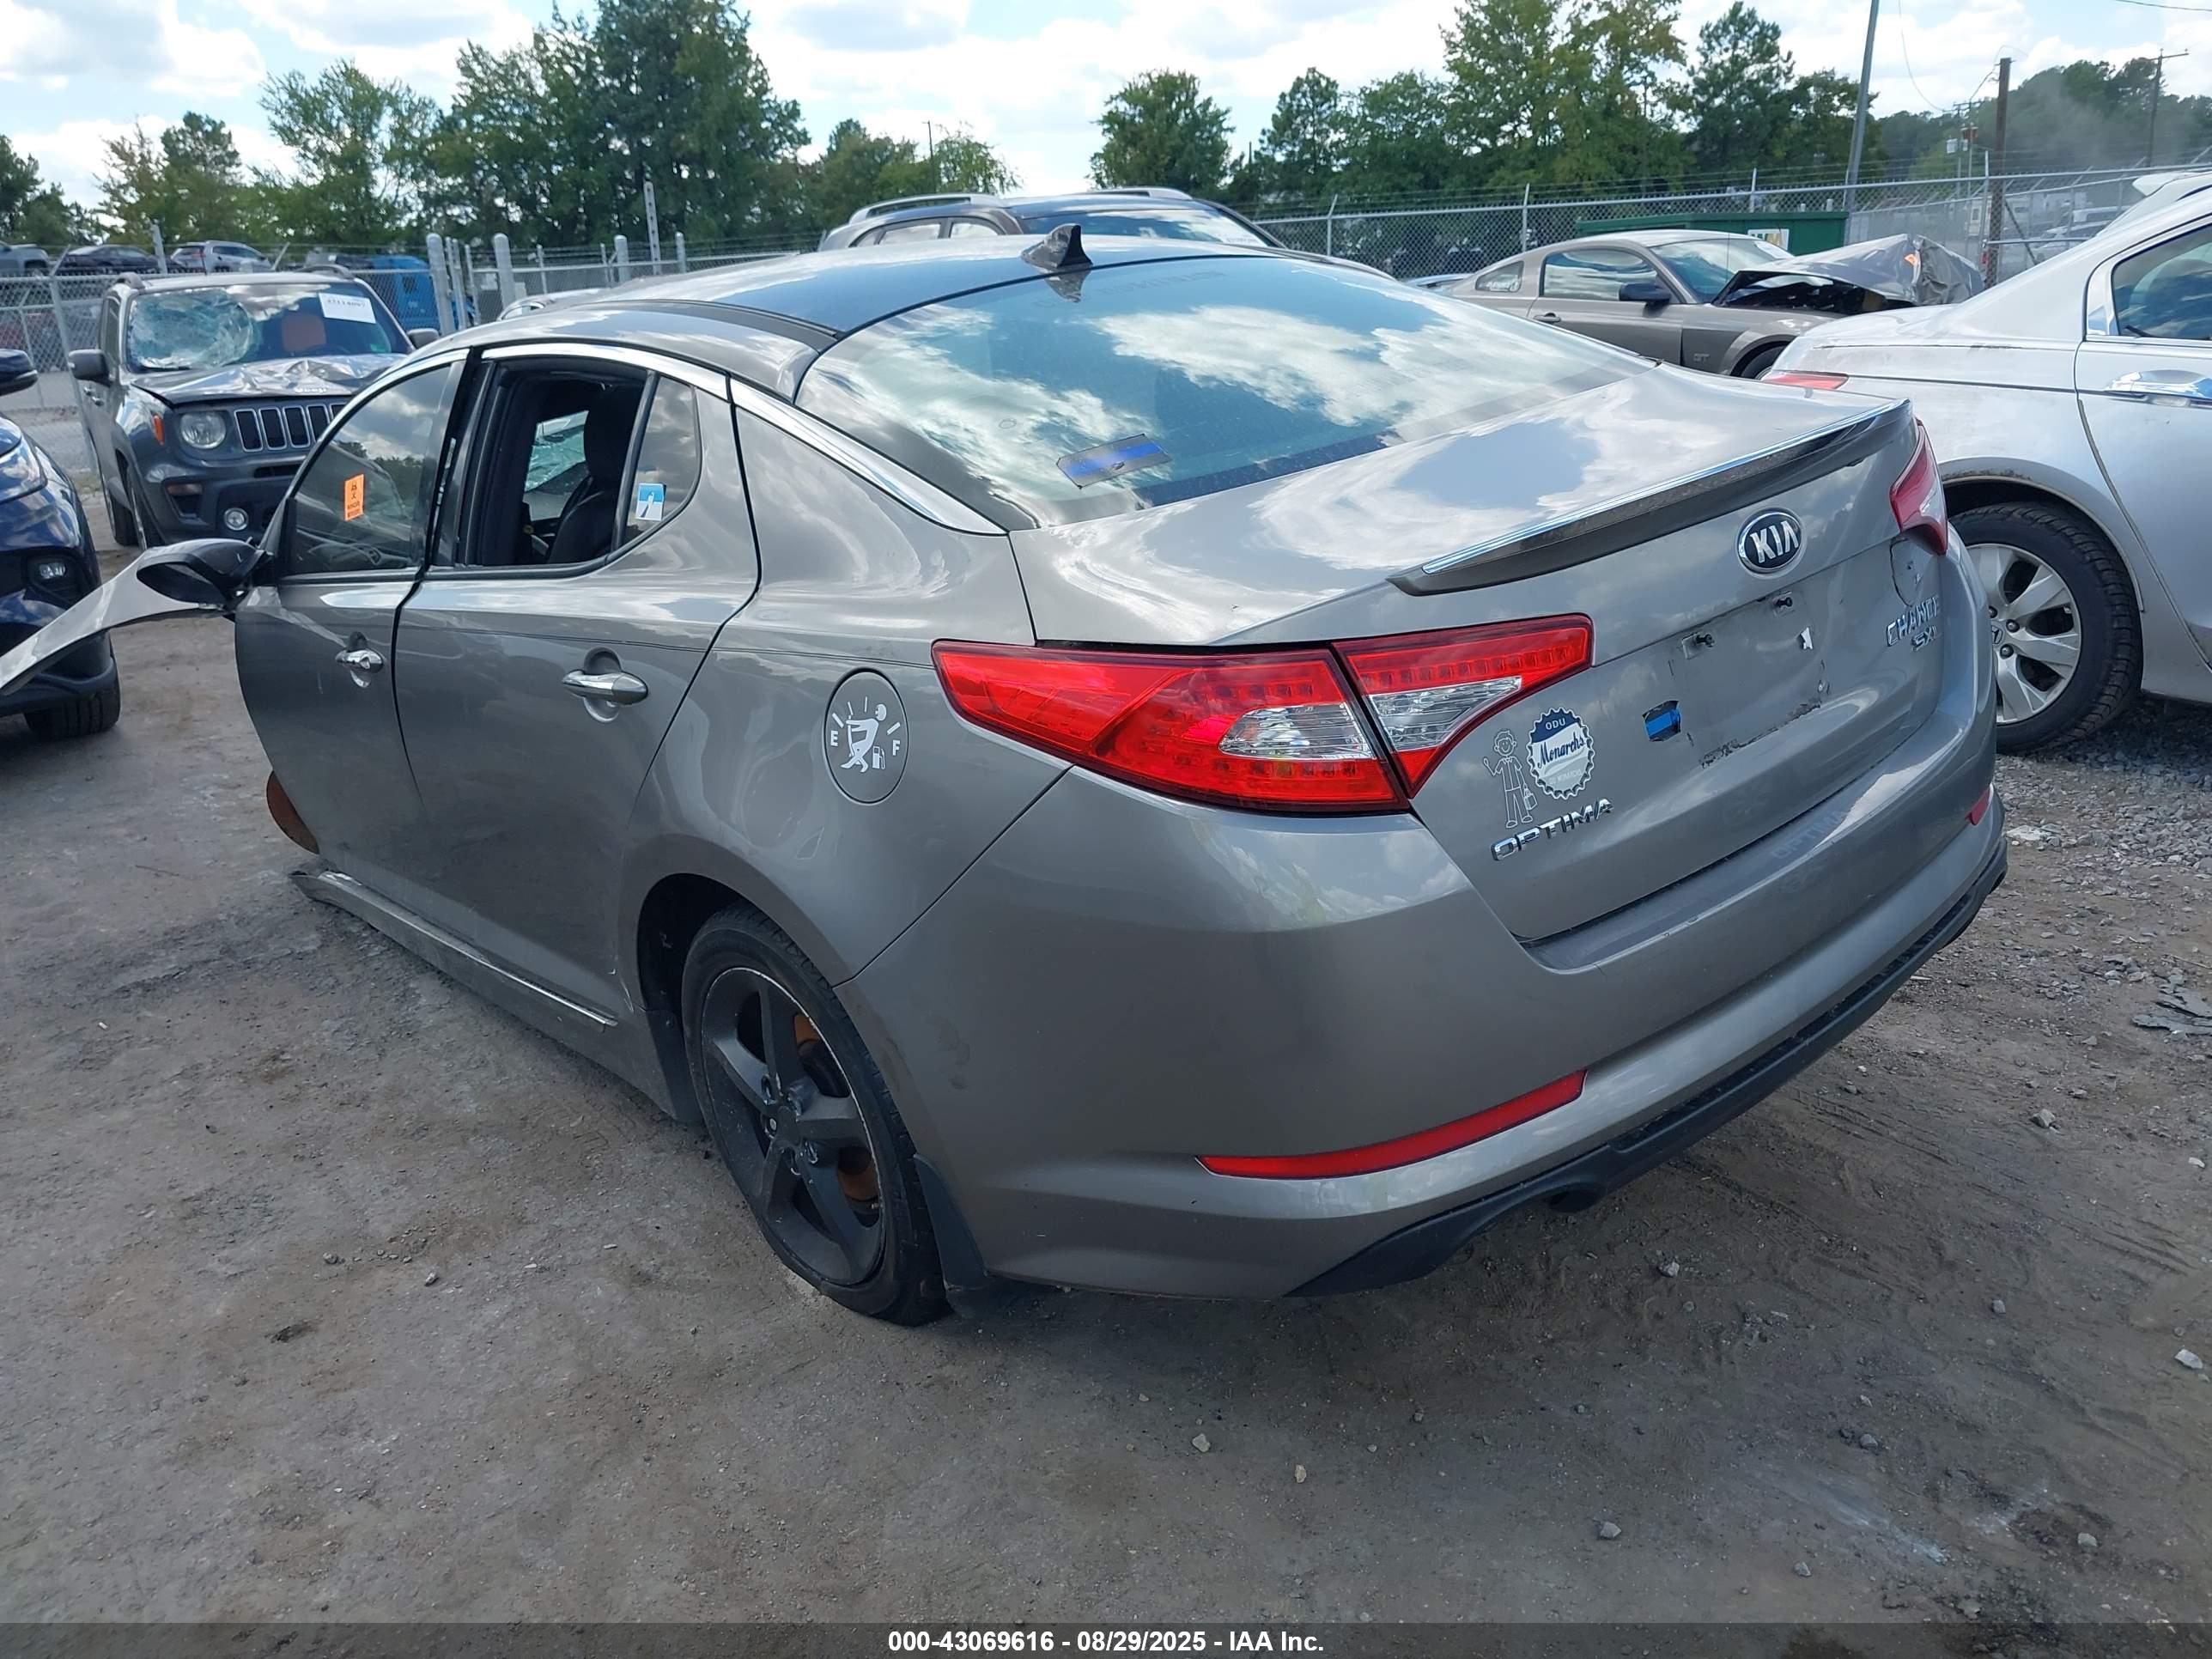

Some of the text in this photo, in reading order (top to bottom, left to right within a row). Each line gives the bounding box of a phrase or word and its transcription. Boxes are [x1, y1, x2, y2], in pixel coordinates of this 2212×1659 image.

[1750, 520, 1799, 563] KIA
[1545, 718, 1566, 730] ODU
[830, 730, 839, 747] E
[892, 739, 901, 757] F
[1537, 732, 1585, 769] Monarchs
[1491, 799, 1614, 861] OPTIMA
